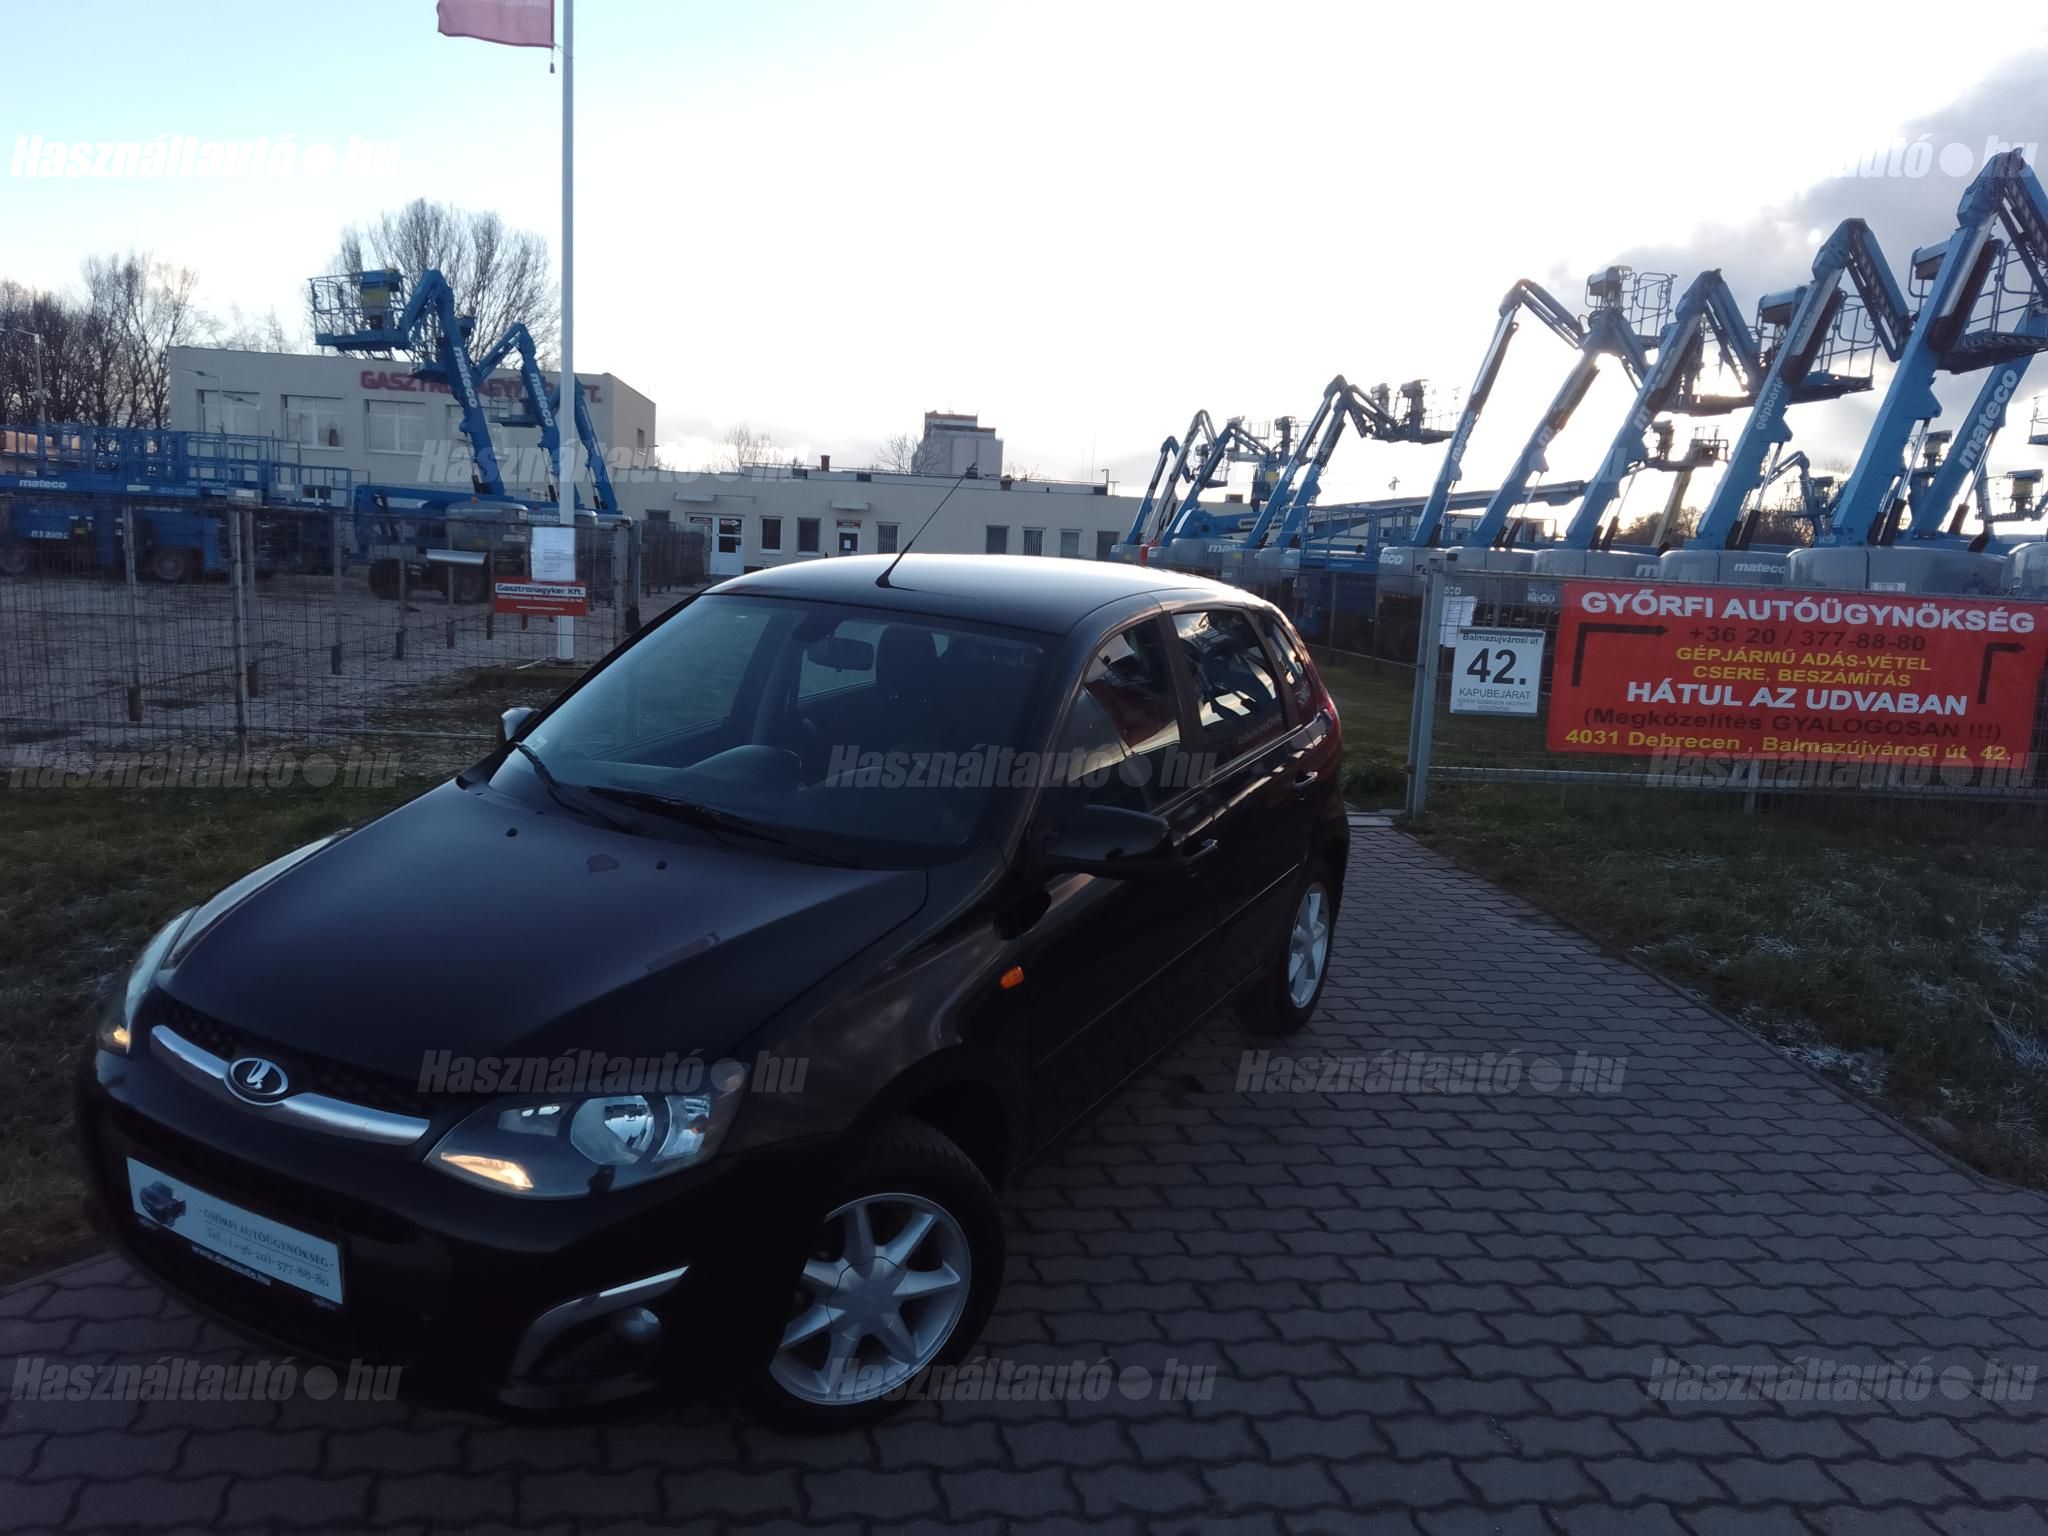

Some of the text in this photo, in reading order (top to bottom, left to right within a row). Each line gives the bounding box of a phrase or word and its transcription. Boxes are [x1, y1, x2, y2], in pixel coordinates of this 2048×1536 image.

[529, 372, 554, 427] mateco
[1959, 369, 2018, 470] mateco
[19, 479, 67, 489] mateco
[1581, 589, 2035, 633] GYŐRFI AUTÓÜGYNÖKSÉG
[1690, 626, 1737, 643] +36
[1745, 628, 1776, 645] 20
[1800, 630, 1926, 651] 377-88-80
[1466, 647, 1527, 685] 42.
[1676, 645, 1931, 670] GÉPJÁRMŰ ADÁS-VÉTEL
[1693, 665, 1911, 686] CSERE, BESZÁMÍTÁS
[1459, 687, 1531, 700] KAPUBEJÁRAT
[1627, 678, 1967, 716] HÁTUL AZ UDVABAN
[1583, 707, 1761, 730] (Megközelítés
[1772, 714, 1959, 738] GYALOGOSAN
[1565, 729, 1618, 745] 4031
[1628, 731, 1740, 750] Debrecen
[1762, 736, 1937, 759] Balmazújvárosi
[1946, 743, 1968, 759] út
[1980, 745, 2011, 761] 42.
